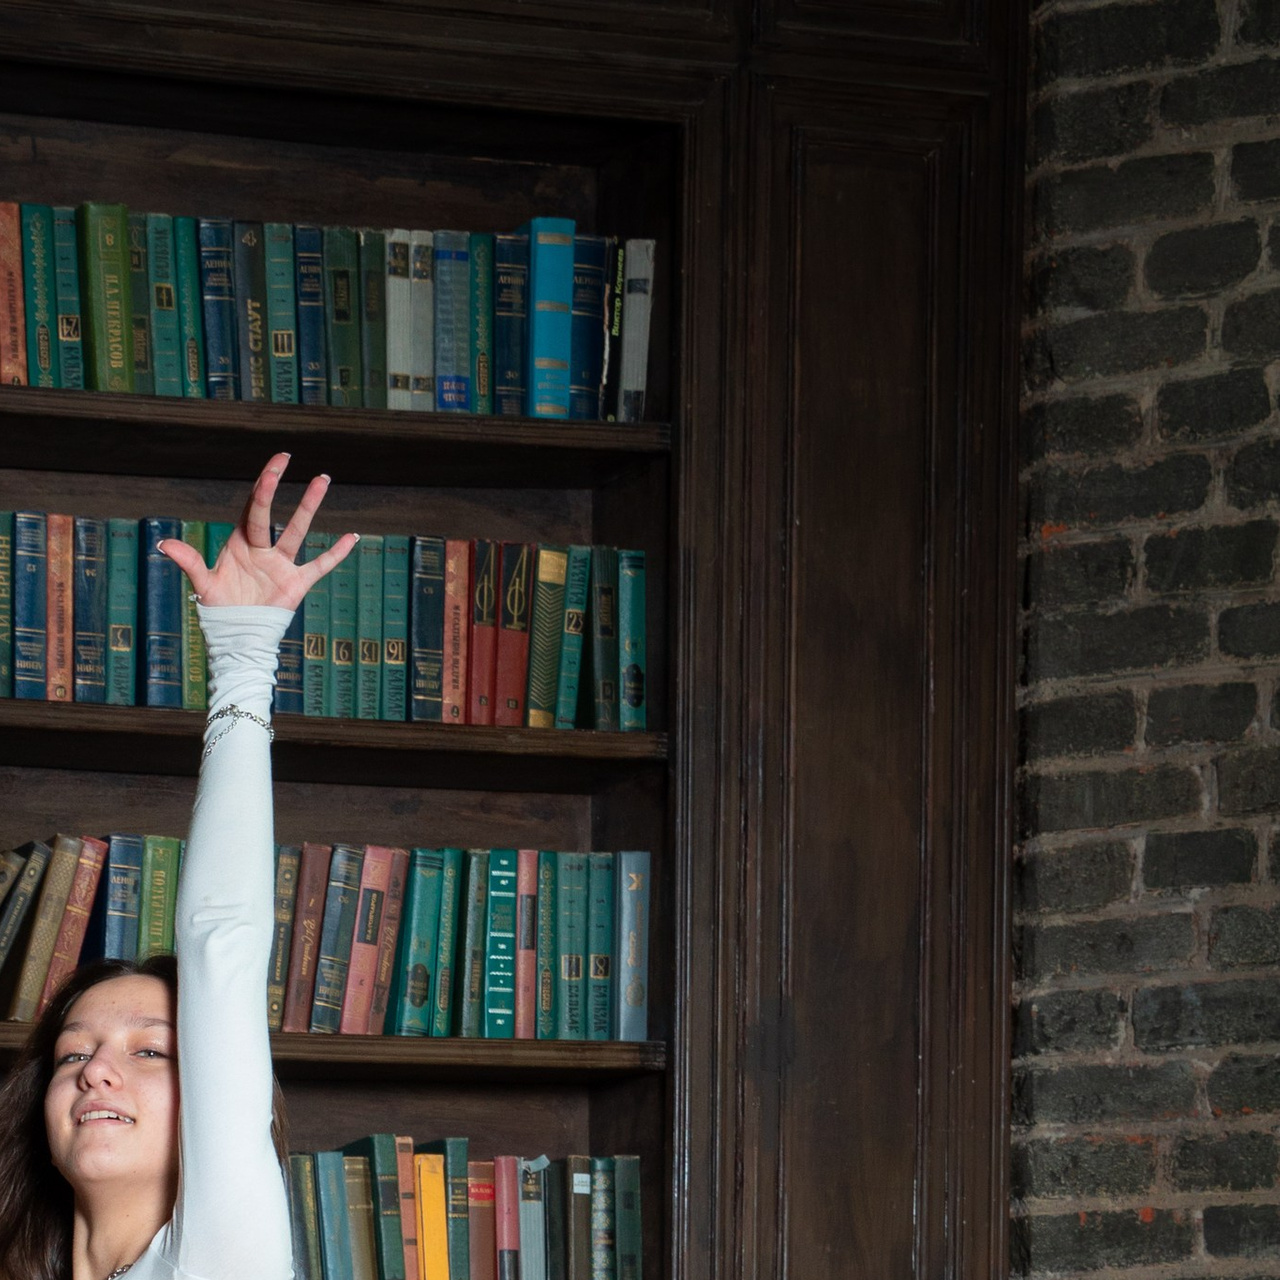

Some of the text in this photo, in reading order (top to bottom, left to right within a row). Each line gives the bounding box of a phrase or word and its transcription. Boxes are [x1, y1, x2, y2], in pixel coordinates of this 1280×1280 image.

[247, 299, 264, 398] РЕКС СТАУТ
[63, 345, 81, 388] БАЛЬЗА
[276, 361, 292, 401] БАЛЬЗА
[307, 638, 324, 657] 12
[337, 642, 349, 661] 9
[362, 642, 378, 661] 13
[387, 642, 405, 661] 16
